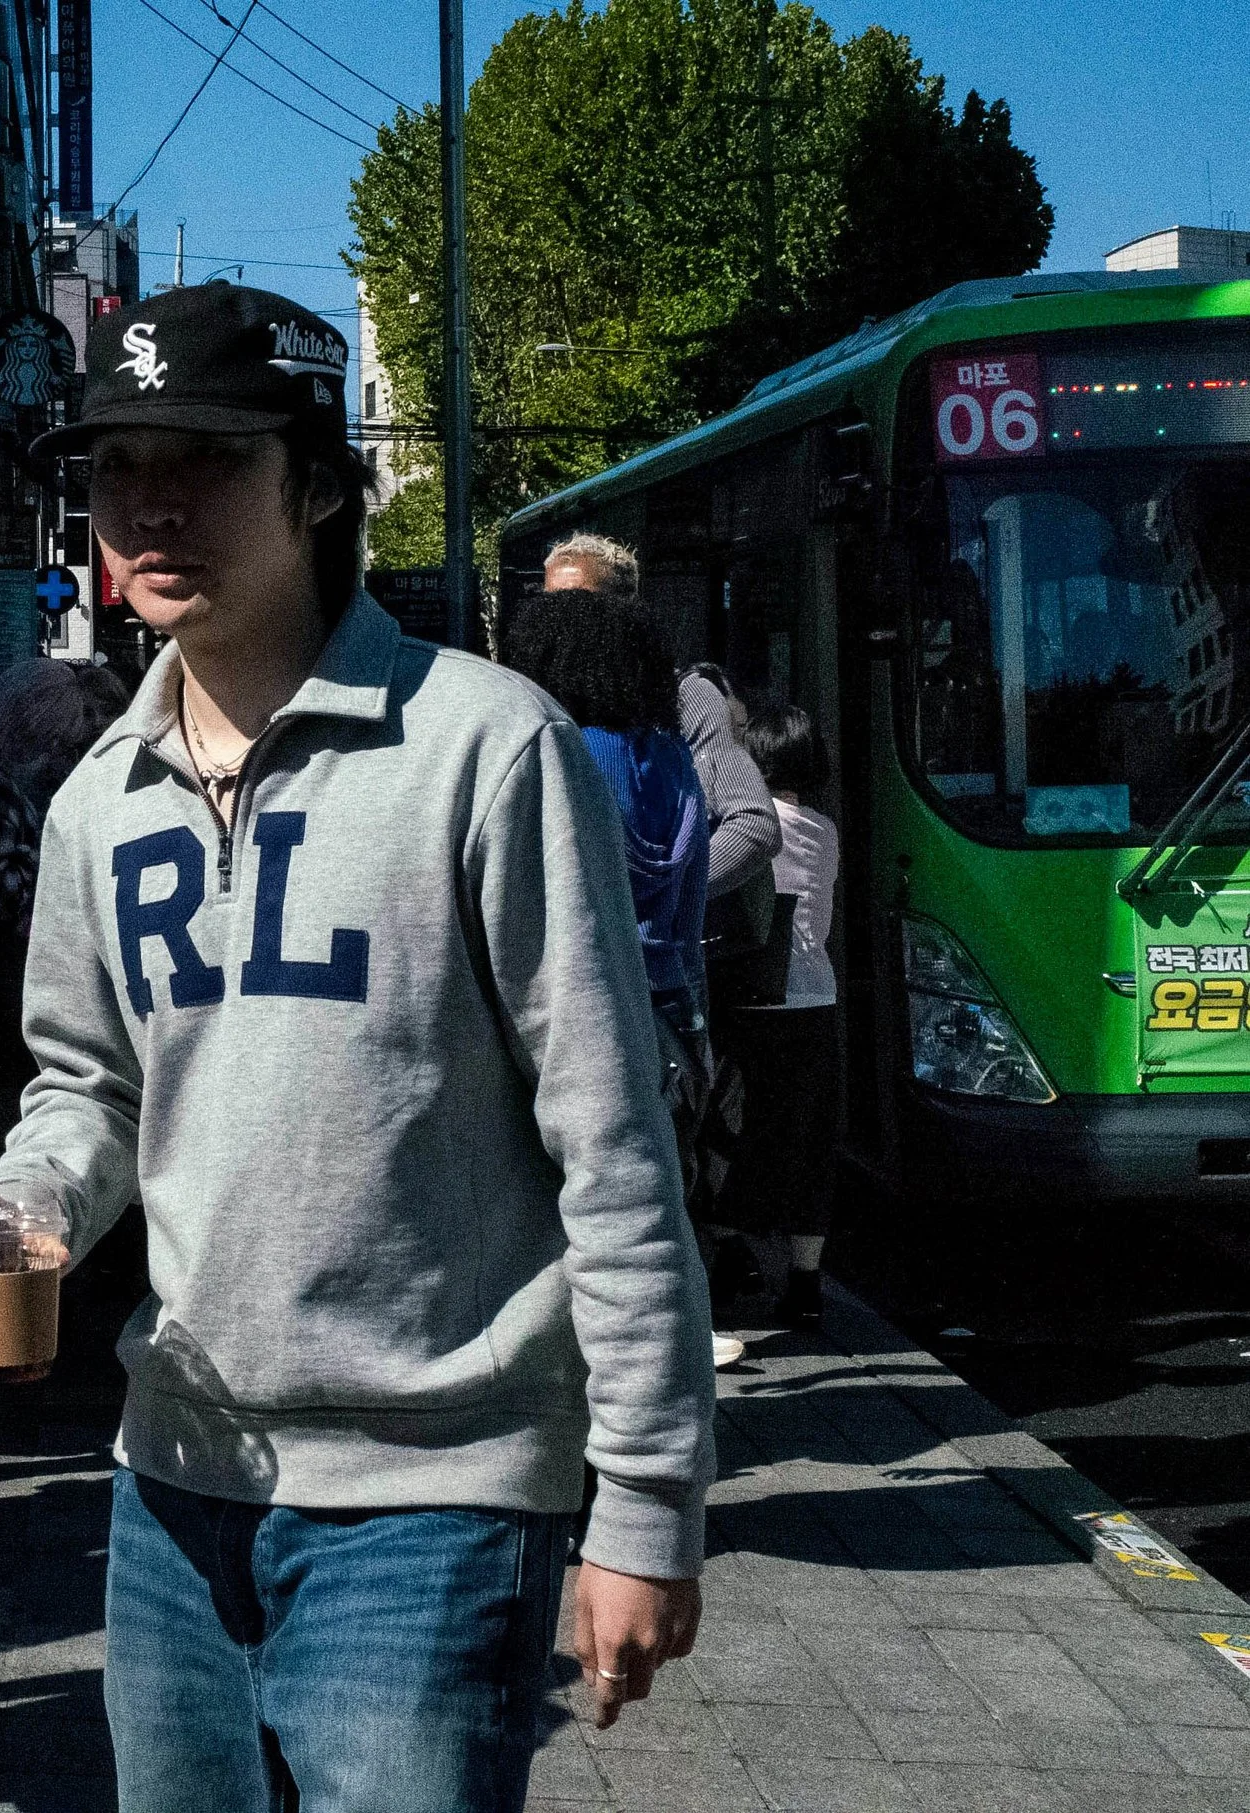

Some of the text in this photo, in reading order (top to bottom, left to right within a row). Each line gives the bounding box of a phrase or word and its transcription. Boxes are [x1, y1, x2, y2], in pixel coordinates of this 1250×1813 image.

[268, 320, 324, 361] White
[957, 362, 1011, 389] 마포
[936, 388, 1040, 456] 06
[1147, 944, 1249, 973] 전국 최저
[1146, 979, 1250, 1031] 요금
